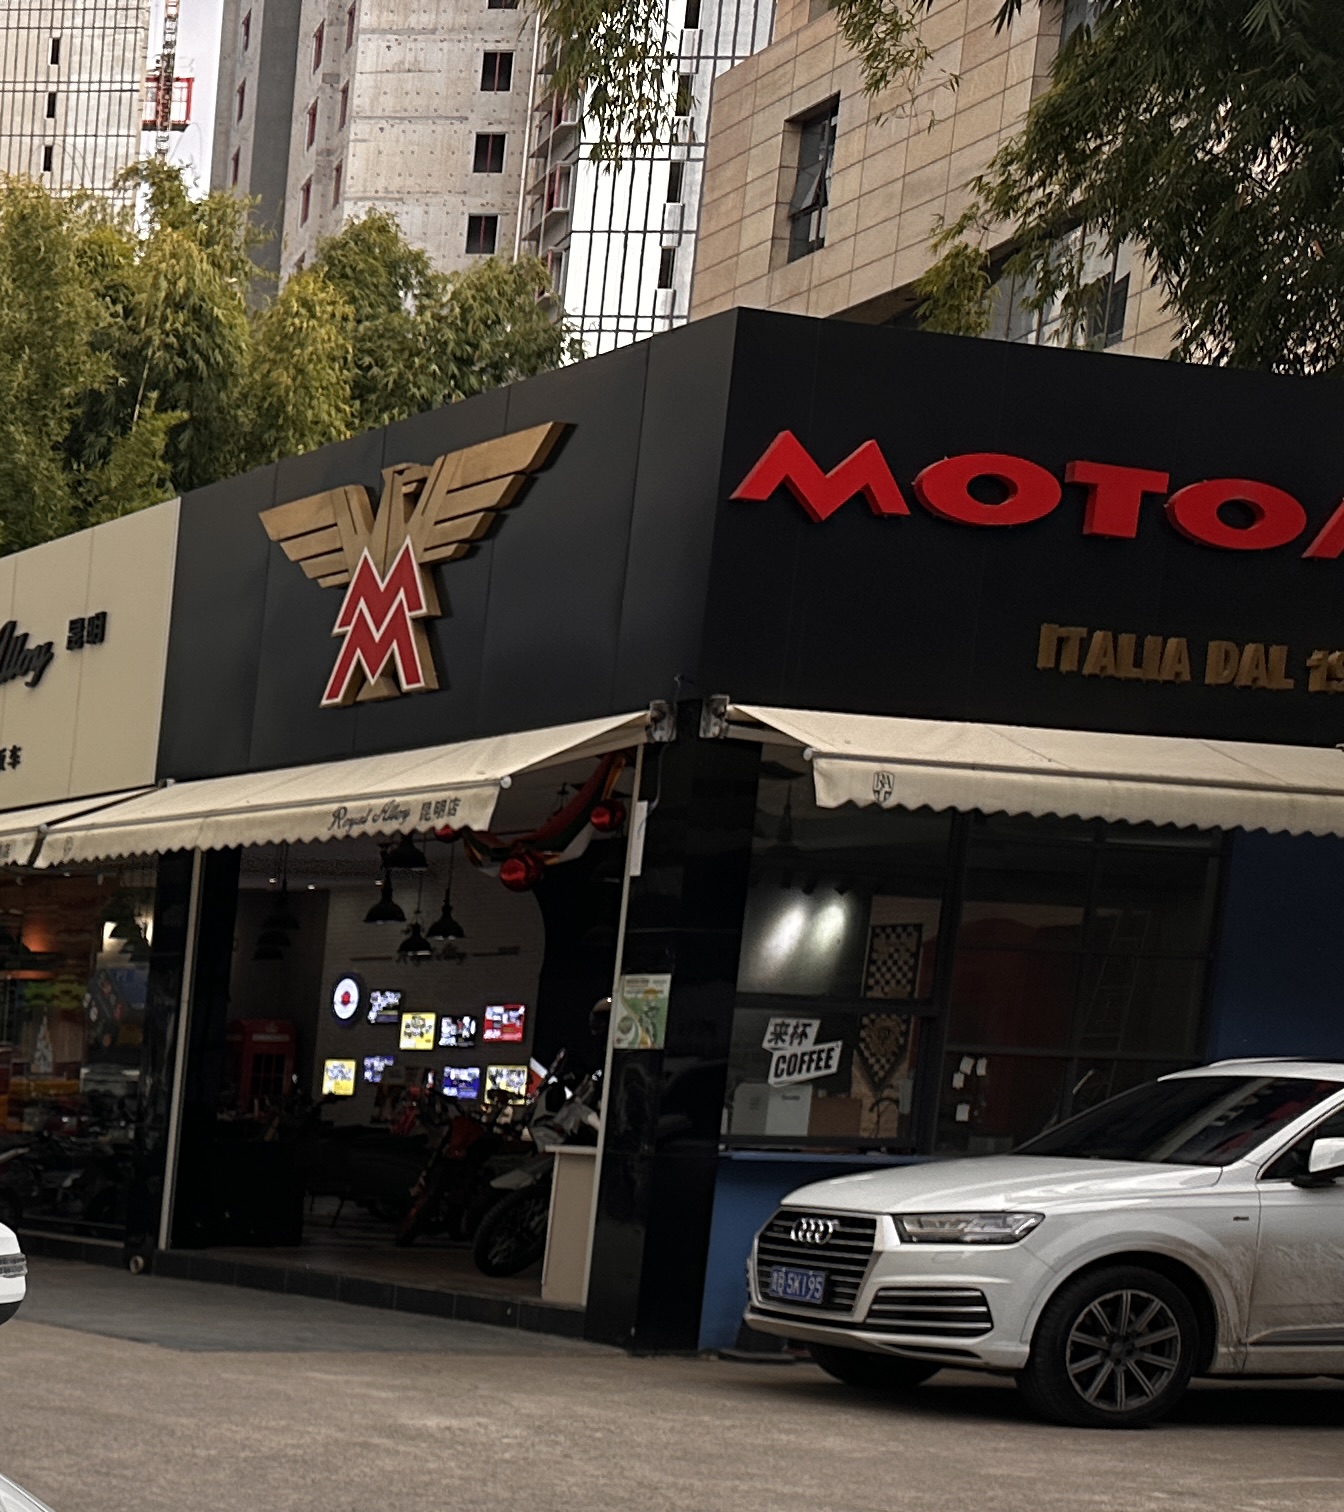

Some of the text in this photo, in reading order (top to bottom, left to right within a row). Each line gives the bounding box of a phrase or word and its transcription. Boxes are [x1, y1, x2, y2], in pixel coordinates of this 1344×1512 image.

[1036, 622, 1191, 682] ITALIA
[1204, 640, 1294, 689] DAL
[774, 1047, 835, 1078] COFFEE
